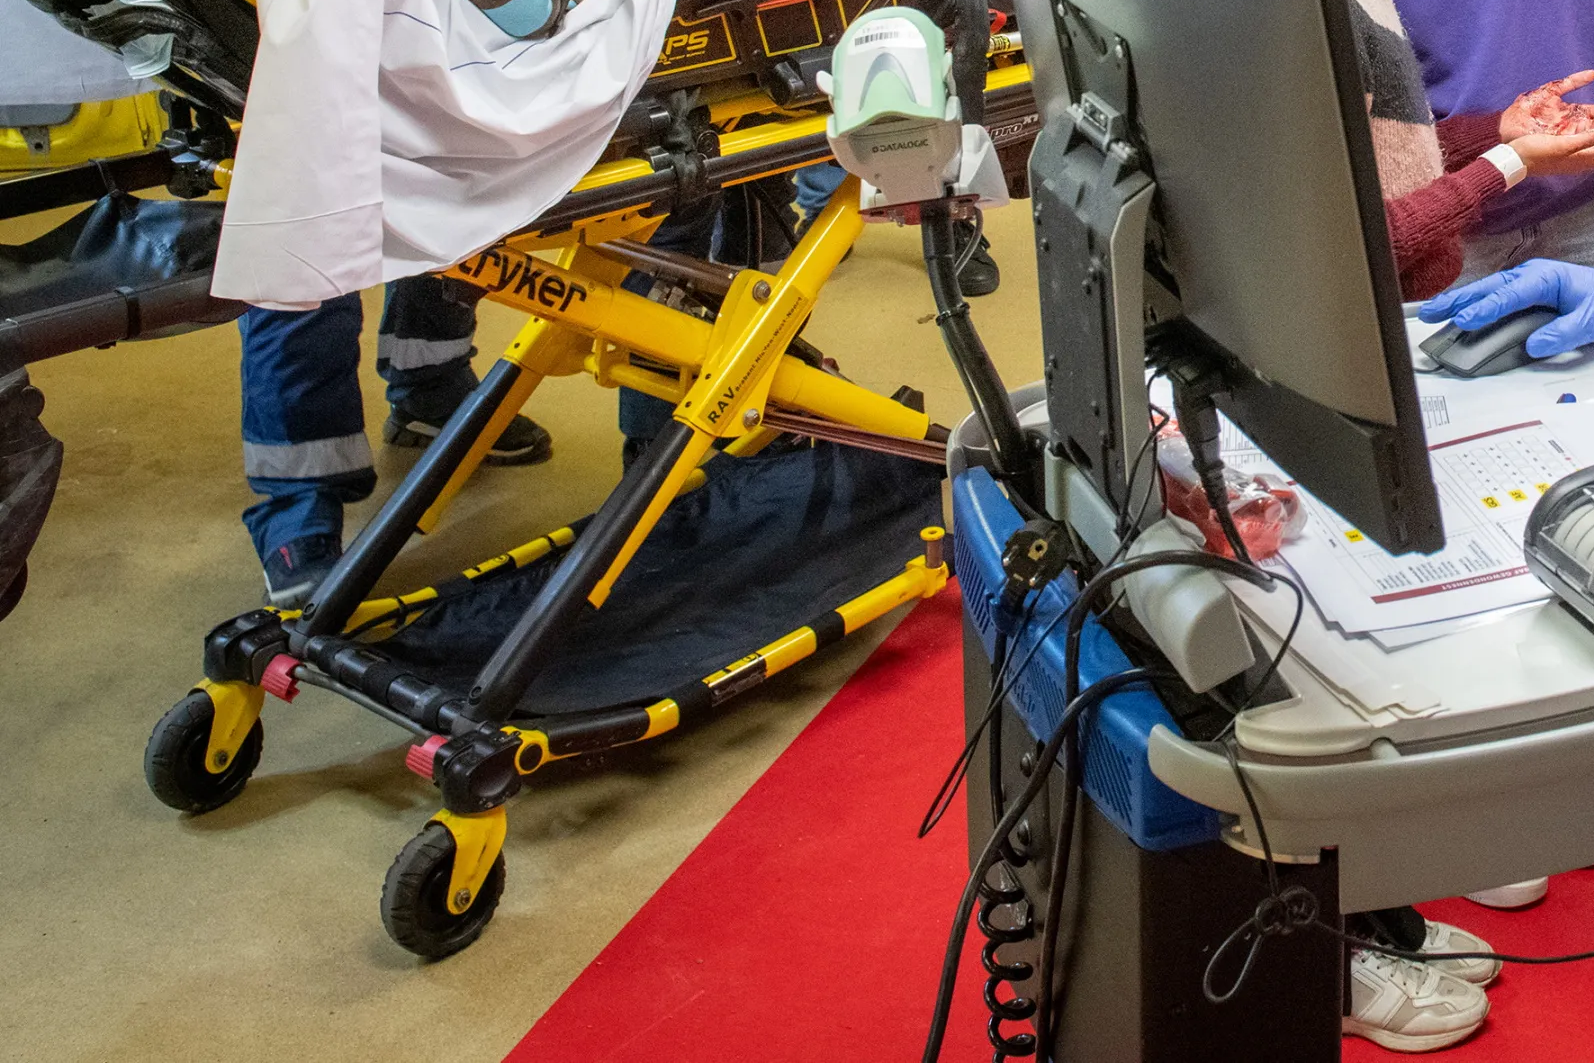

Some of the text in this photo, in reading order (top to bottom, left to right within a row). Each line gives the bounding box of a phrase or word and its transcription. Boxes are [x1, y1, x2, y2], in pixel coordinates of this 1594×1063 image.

[661, 29, 710, 55] PS
[988, 123, 1022, 141] pro
[880, 138, 929, 152] DATALOGIC
[707, 386, 735, 424] RAV
